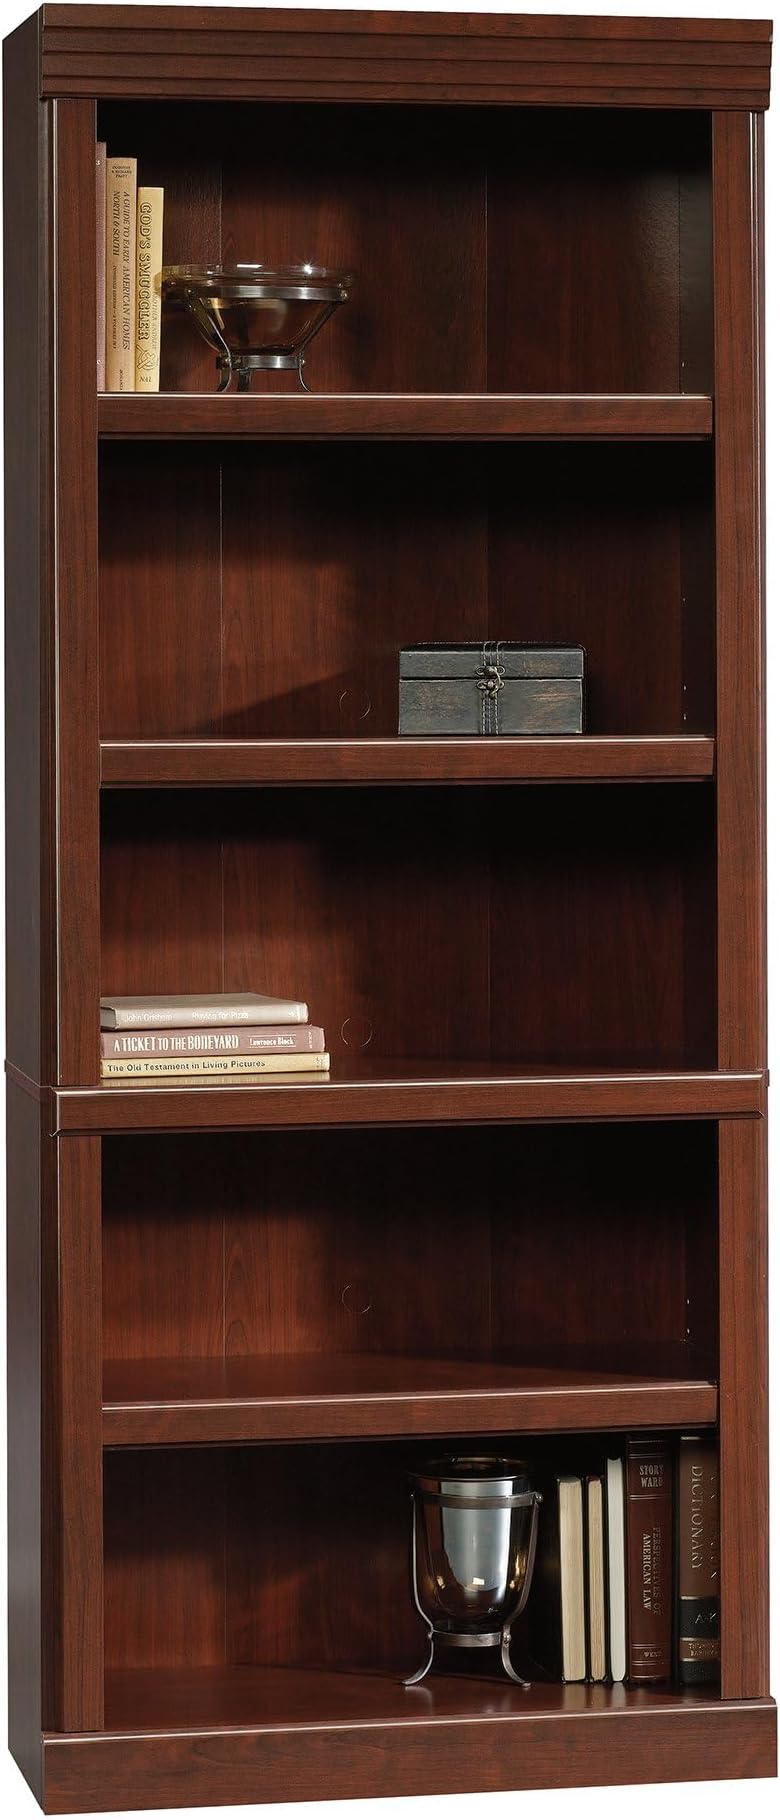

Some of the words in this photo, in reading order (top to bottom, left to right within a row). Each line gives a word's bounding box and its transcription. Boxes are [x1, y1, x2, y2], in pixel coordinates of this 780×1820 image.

[122, 200, 131, 225] GUIDE
[140, 202, 152, 250] GOD'S
[122, 226, 131, 238] TO
[122, 239, 130, 264] EARLY
[122, 265, 130, 314] AMERICAN
[138, 252, 152, 340] SMUGGLER
[122, 316, 130, 350] HOMES
[114, 1040, 120, 1052] A
[121, 1036, 156, 1052] TICKET
[157, 1037, 168, 1051] TO
[170, 1036, 186, 1050] THE
[108, 1064, 124, 1072] The
[126, 1064, 142, 1072] Old
[144, 1063, 189, 1071] Testament
[202, 1061, 228, 1070] Living
[231, 1060, 266, 1068] Pictures
[690, 1466, 704, 1568] DICTIONARY
[642, 1533, 652, 1585] AMERICAN
[643, 1590, 652, 1610] LAW
